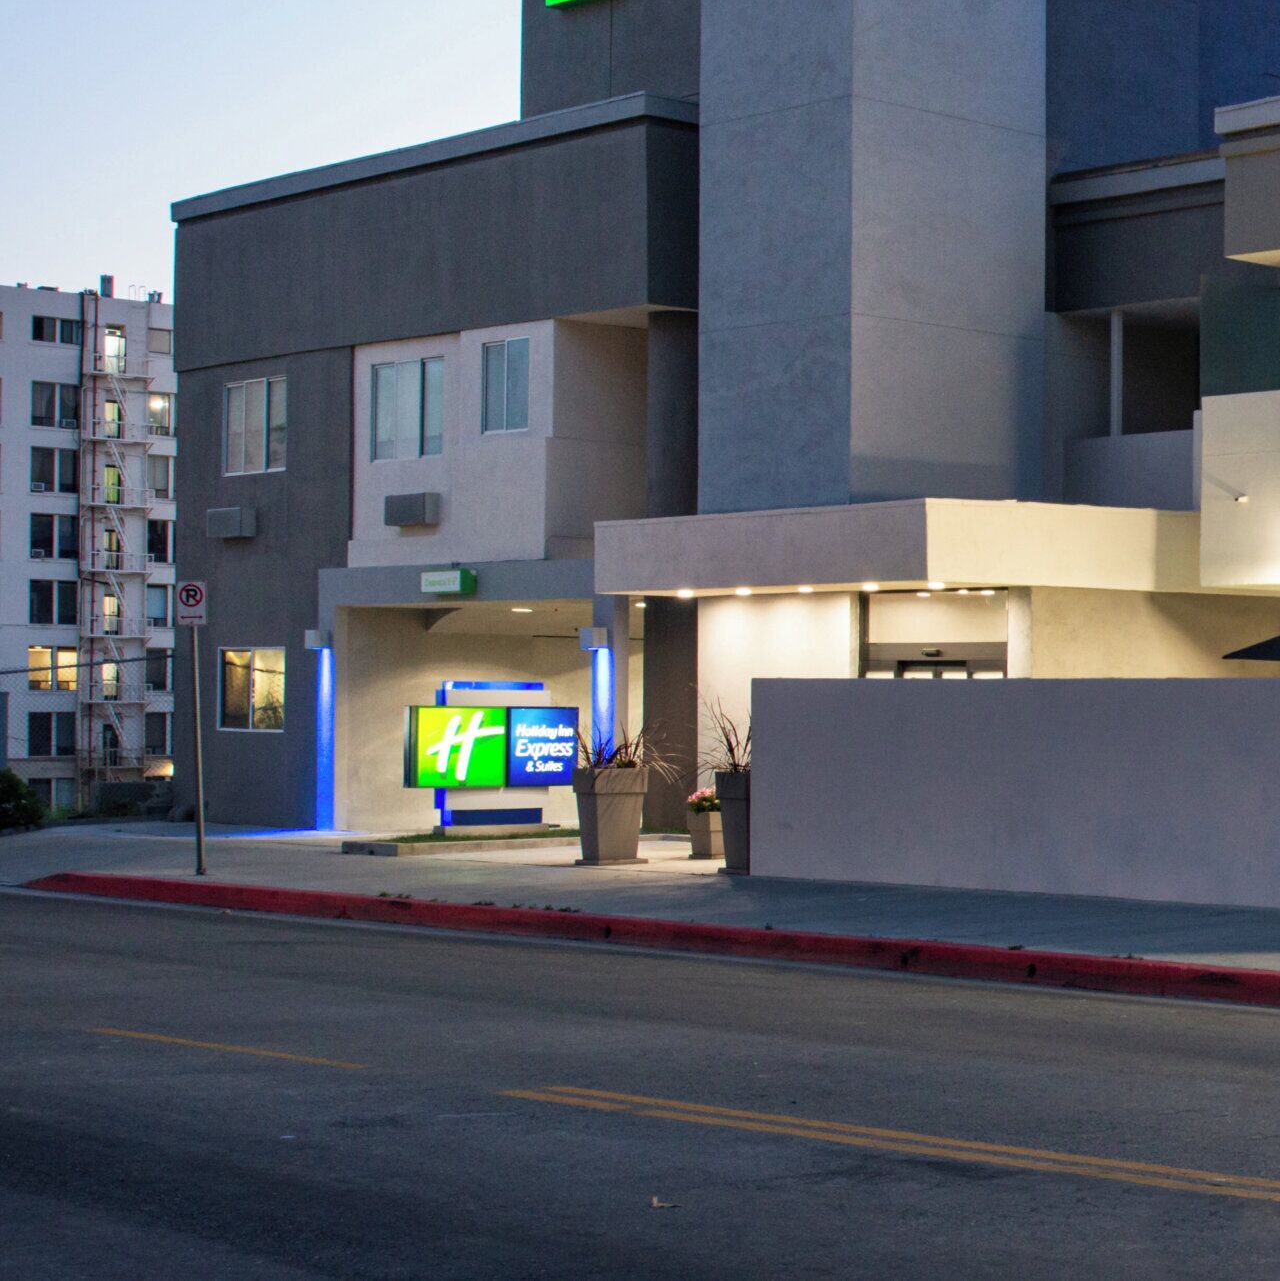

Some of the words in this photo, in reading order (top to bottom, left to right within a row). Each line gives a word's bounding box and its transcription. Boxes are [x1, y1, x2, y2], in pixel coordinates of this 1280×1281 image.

[515, 723, 558, 740] Holiday
[558, 723, 574, 737] Inn
[514, 739, 574, 760] Express
[525, 760, 534, 772] &
[534, 760, 564, 772] Suites
